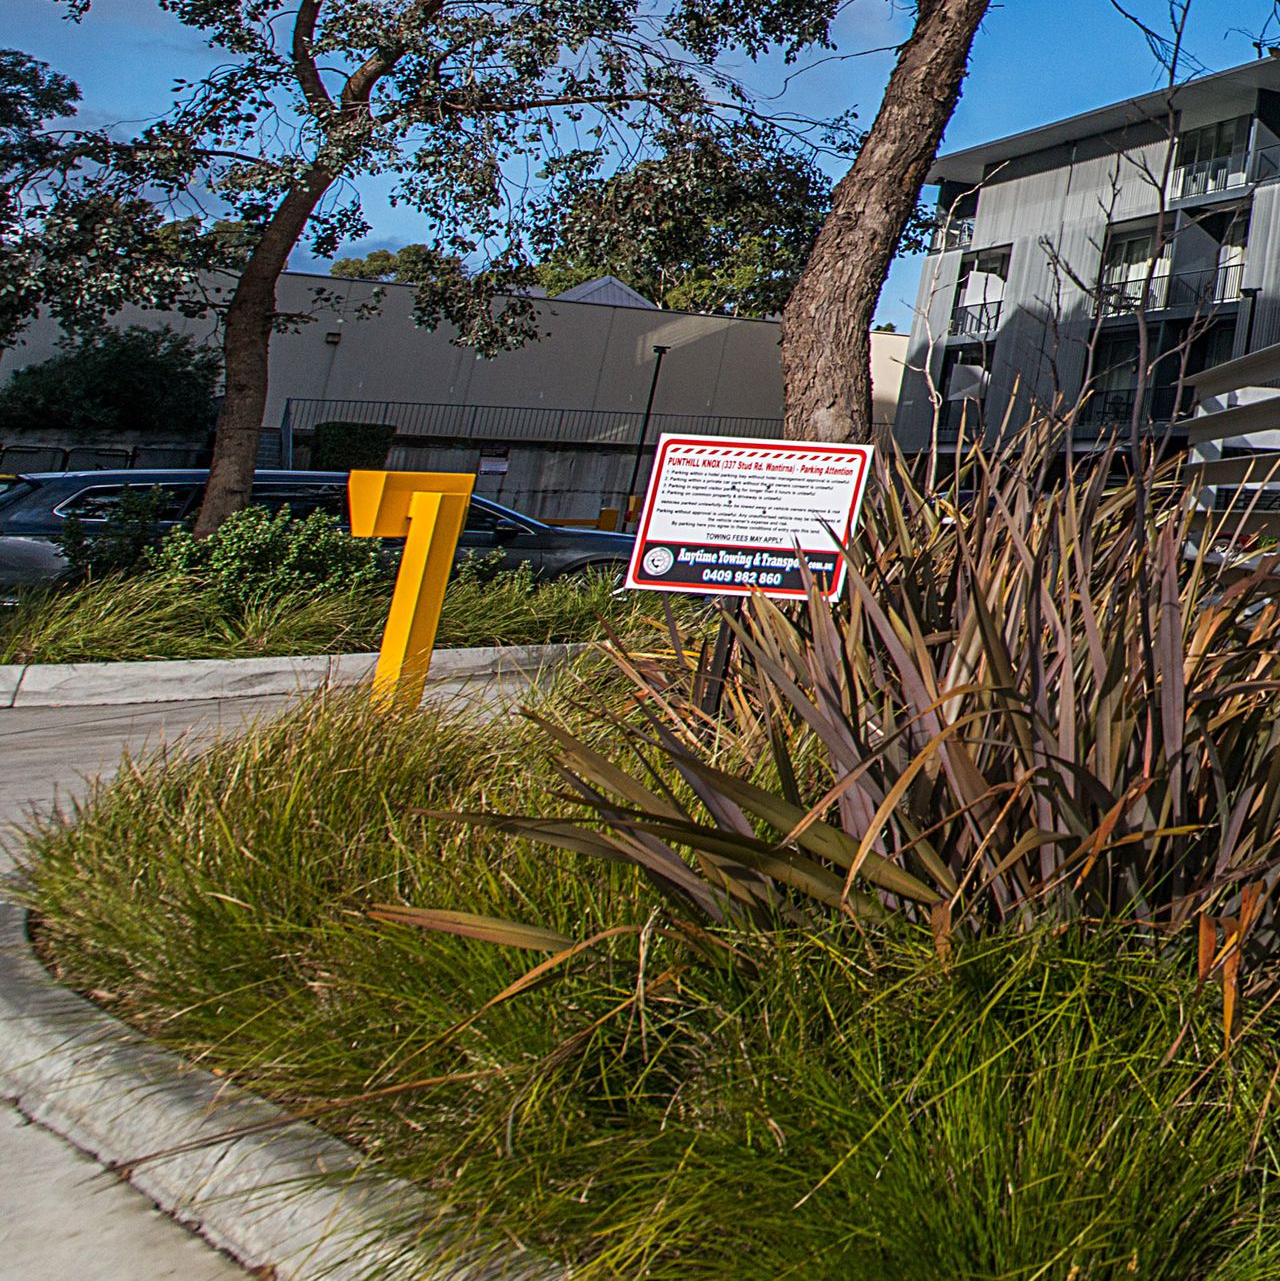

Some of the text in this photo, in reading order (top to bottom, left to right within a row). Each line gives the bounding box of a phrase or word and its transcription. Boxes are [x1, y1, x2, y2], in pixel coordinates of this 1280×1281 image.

[668, 457, 700, 468] PUNTHILL
[702, 459, 721, 468] KNOX
[722, 460, 737, 470] (337
[737, 461, 753, 470] Stud
[766, 463, 795, 472] Wantirna)
[800, 464, 824, 476] Parking
[824, 466, 853, 476] Attention
[707, 533, 731, 541] TOWING
[678, 548, 717, 566] Anytime
[718, 550, 752, 568] Towing
[753, 552, 762, 566] &
[762, 552, 809, 572] Transpo
[702, 569, 782, 585] 0409 982 860
